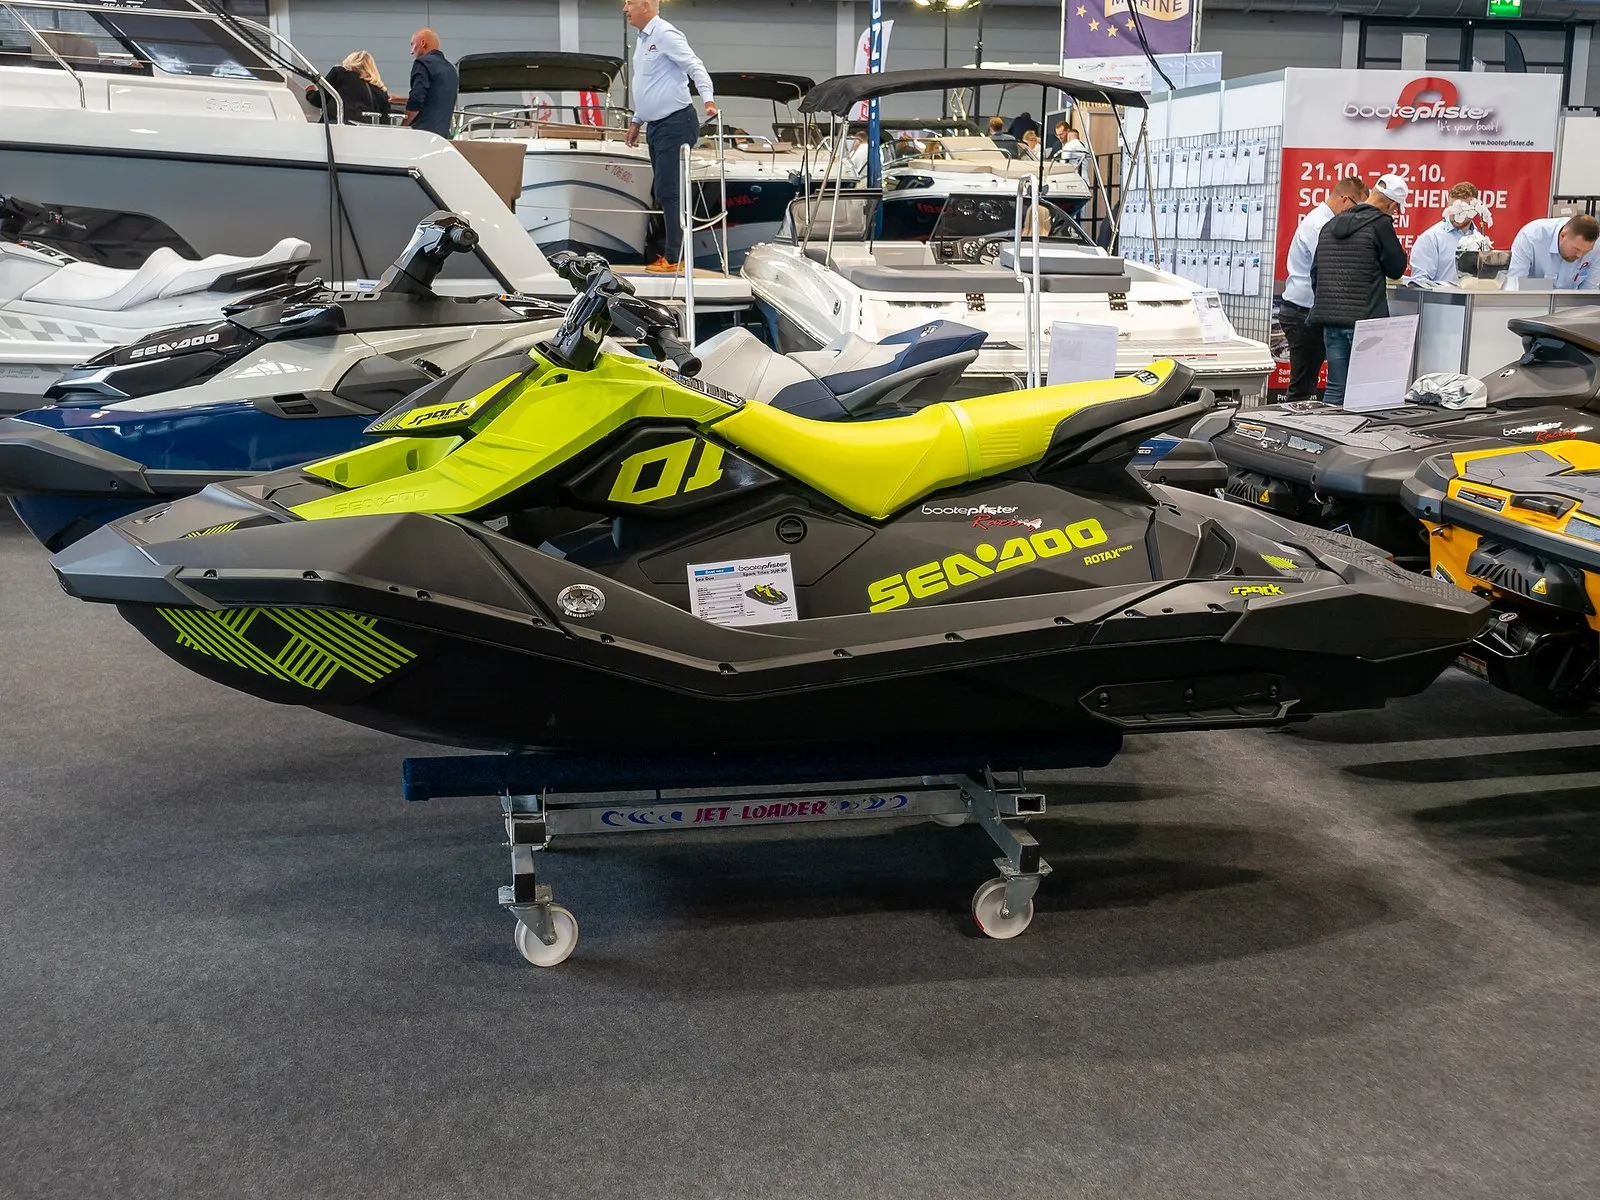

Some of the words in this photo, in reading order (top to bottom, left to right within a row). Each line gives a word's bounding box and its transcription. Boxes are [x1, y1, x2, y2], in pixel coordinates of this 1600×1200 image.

[1111, 0, 1183, 12] MRINE
[1342, 100, 1494, 123] bootepfister
[1469, 138, 1535, 147] www.bootepfister.de
[1300, 161, 1363, 181] 21.10.
[921, 504, 1018, 516] bootepfister
[1083, 548, 1121, 566] ROTAX
[738, 561, 788, 572] bootepfister
